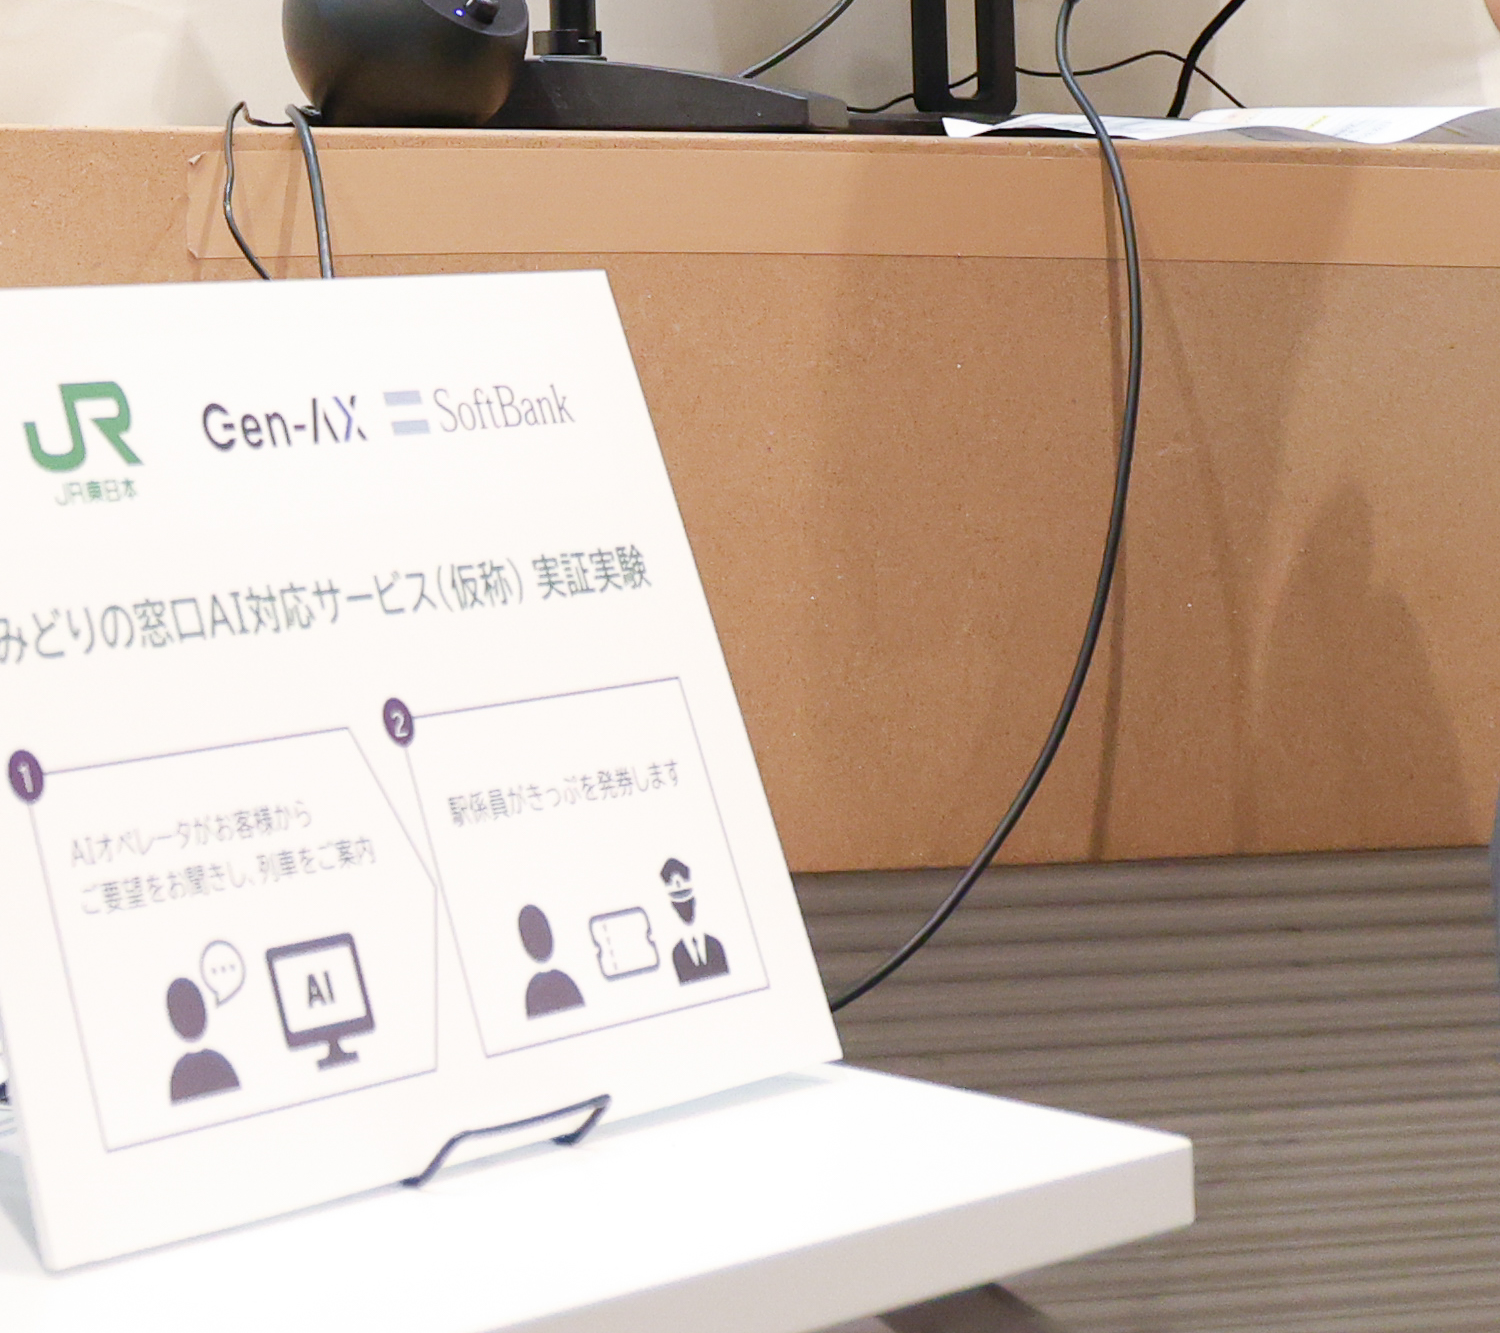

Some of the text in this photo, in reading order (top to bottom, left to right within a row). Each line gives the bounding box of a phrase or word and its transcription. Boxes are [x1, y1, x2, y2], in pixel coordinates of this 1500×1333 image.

[201, 395, 368, 453] Gen-AX
[434, 384, 576, 435] SoftBank
[55, 478, 138, 507] JR東日本
[447, 759, 680, 828] 駅係員がきっぷを発券します
[71, 800, 313, 869] AIオペレータがお客様から
[80, 835, 377, 916] ご要望をお聞きし、列車をご案内
[307, 969, 336, 1009] AI
